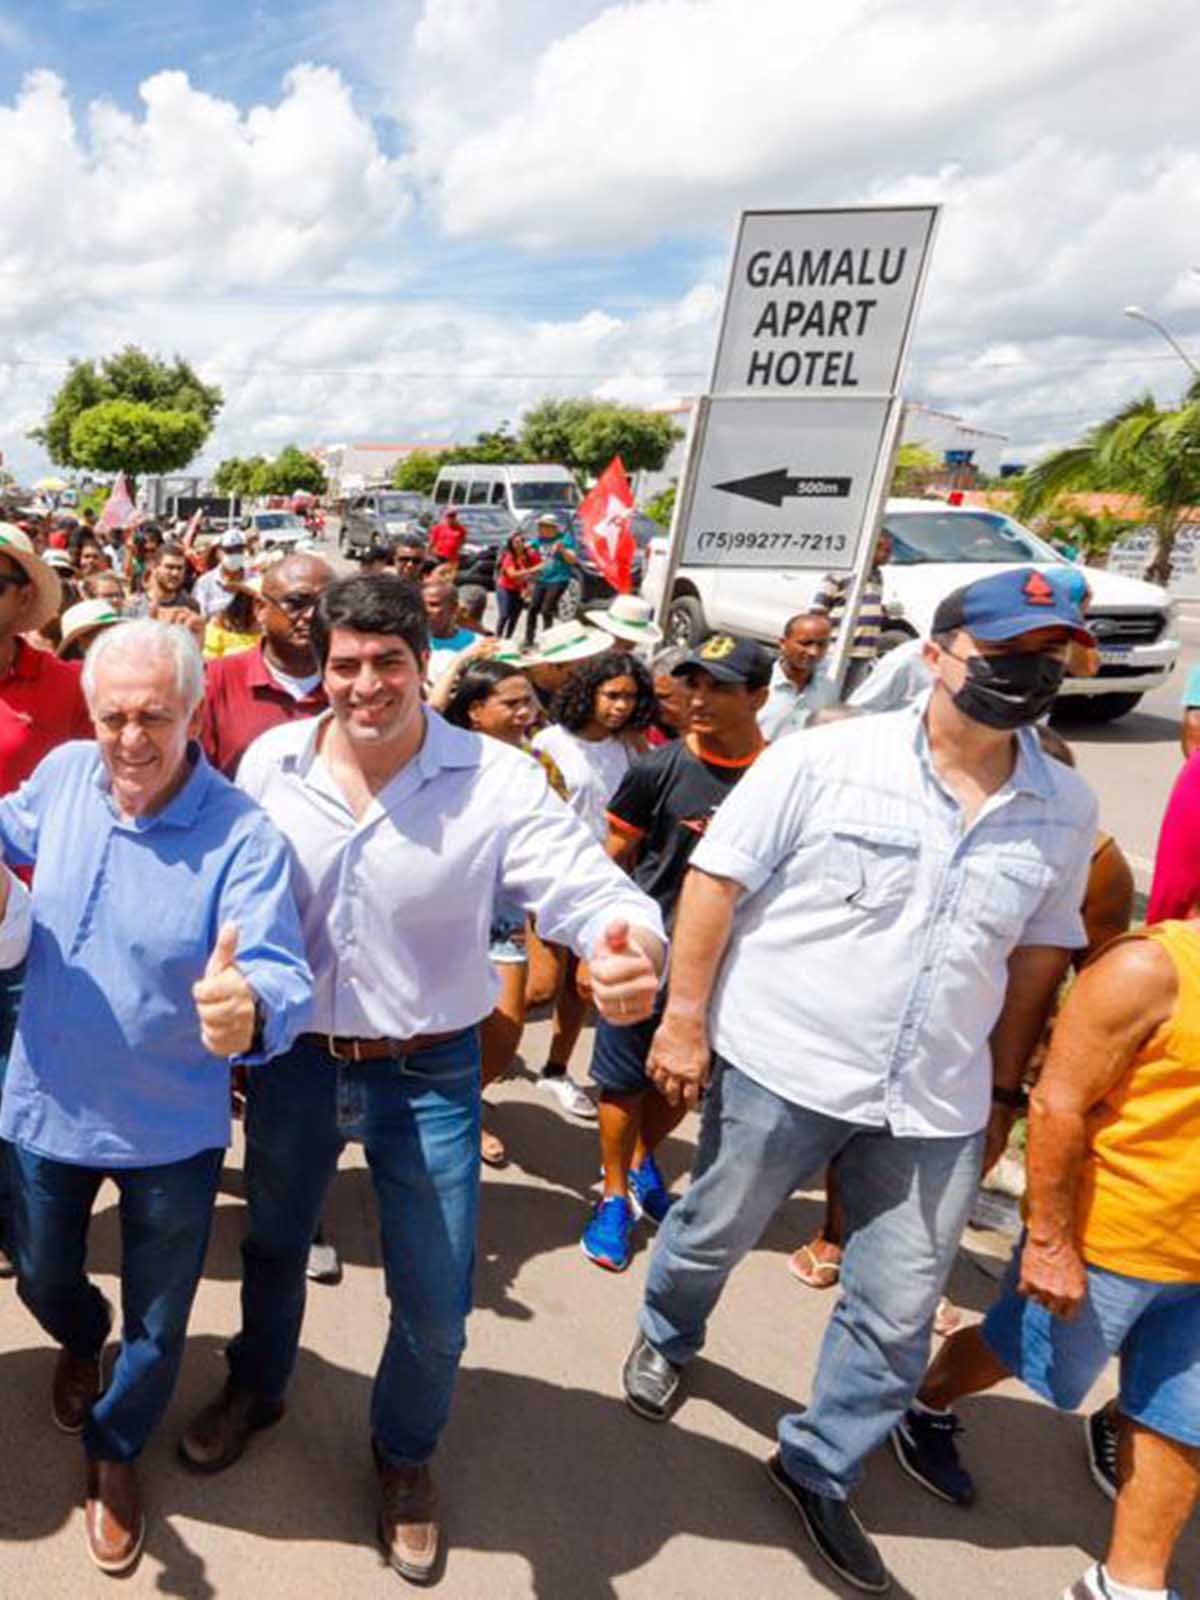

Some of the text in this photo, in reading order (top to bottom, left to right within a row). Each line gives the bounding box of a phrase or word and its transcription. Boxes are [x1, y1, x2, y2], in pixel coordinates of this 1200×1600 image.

[746, 247, 907, 288] GAMALU
[753, 299, 877, 338] APART
[747, 351, 859, 387] HOTEL
[796, 481, 839, 494] 500m
[696, 530, 847, 552] (75)99277-7213
